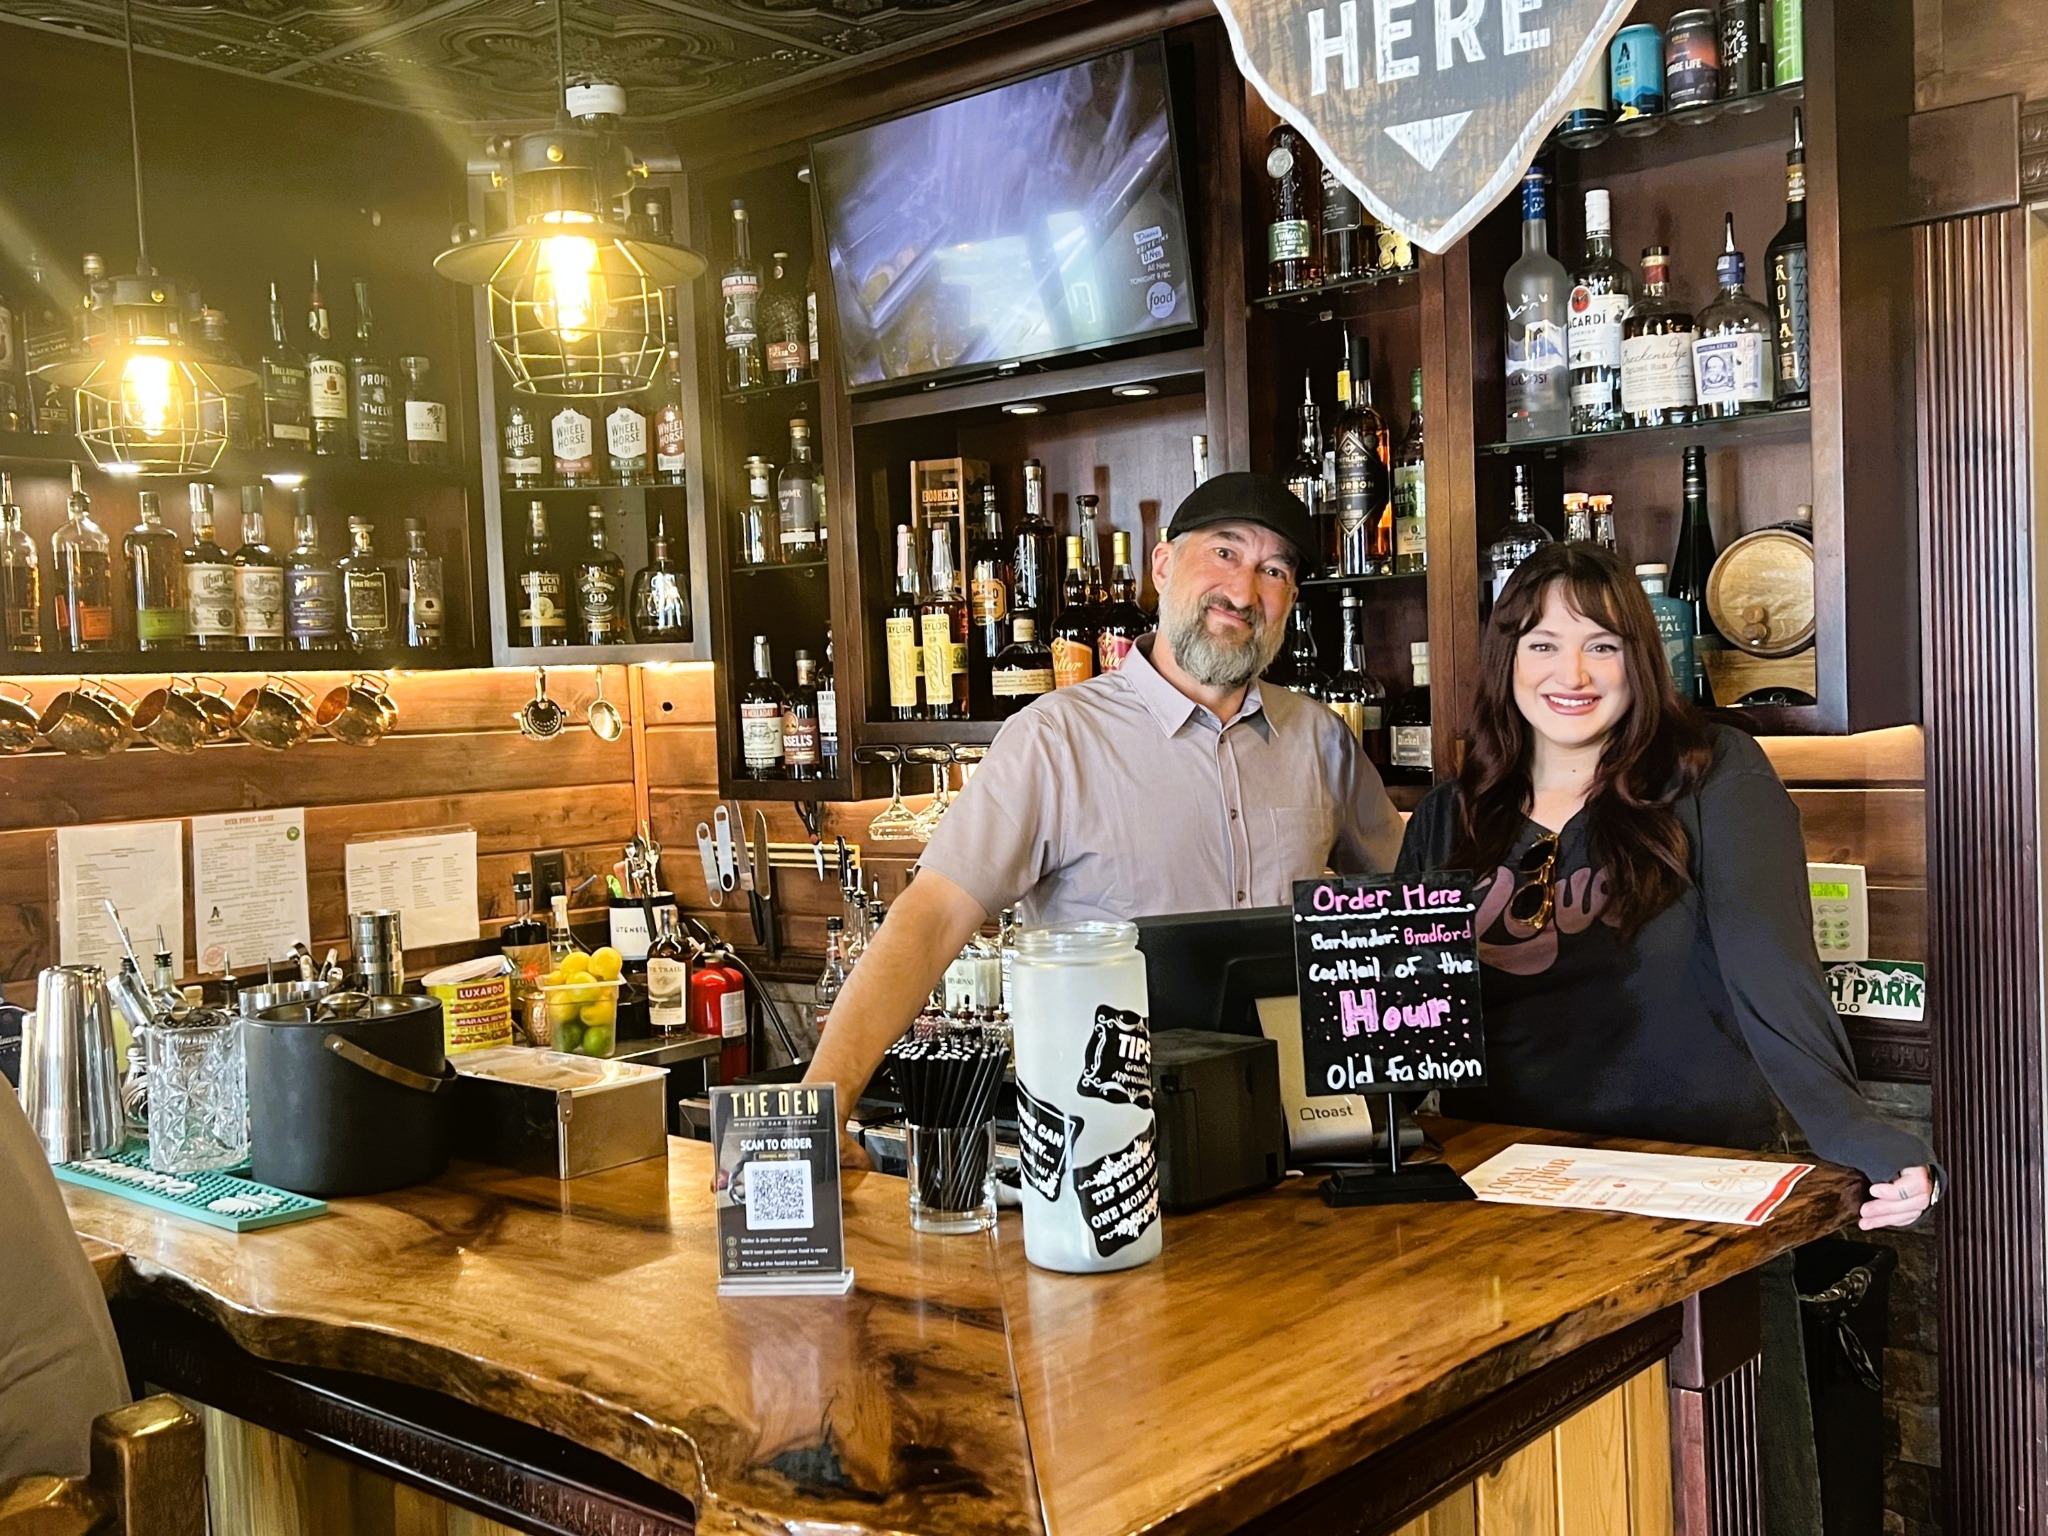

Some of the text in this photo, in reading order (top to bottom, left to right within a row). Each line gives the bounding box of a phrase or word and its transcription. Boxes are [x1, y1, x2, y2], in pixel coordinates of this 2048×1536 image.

[1307, 0, 1551, 97] HERE
[1149, 288, 1175, 313] food
[504, 423, 534, 440] WHEEL
[556, 423, 585, 440] WHEEL
[611, 423, 640, 440] WHEEL
[657, 421, 684, 436] WHEEL
[659, 431, 685, 448] HORSE
[506, 434, 535, 449] HORSE
[558, 433, 586, 449] HORSE
[612, 433, 641, 449] HORSE
[520, 575, 560, 588] KENTUCKY
[1313, 883, 1462, 912] Order Here
[1310, 919, 1472, 950] Bartender: Bradford
[660, 965, 682, 974] TRAIL
[1308, 951, 1474, 982] Cocktail of the
[459, 984, 504, 999] LUXARDO
[1852, 978, 1923, 1008] PARK
[1338, 987, 1451, 1038] Hour
[1118, 1032, 1152, 1065] TIPS
[1326, 1054, 1374, 1090] Old
[730, 1089, 819, 1118] THE DEN
[1315, 1104, 1354, 1120] toast
[733, 1120, 765, 1128] WHISKEY
[1037, 1123, 1065, 1149] CAN
[740, 1137, 813, 1152] SCAN TO ORDER
[1091, 1185, 1116, 1206] TIP
[1116, 1173, 1137, 1194] ME
[1478, 1165, 1541, 1196] LOCAL
[1503, 1158, 1578, 1199] AUTHOR
[1530, 1177, 1582, 1201] FAIR
[1091, 1206, 1121, 1229] ONE
[1119, 1183, 1150, 1215] MORE
